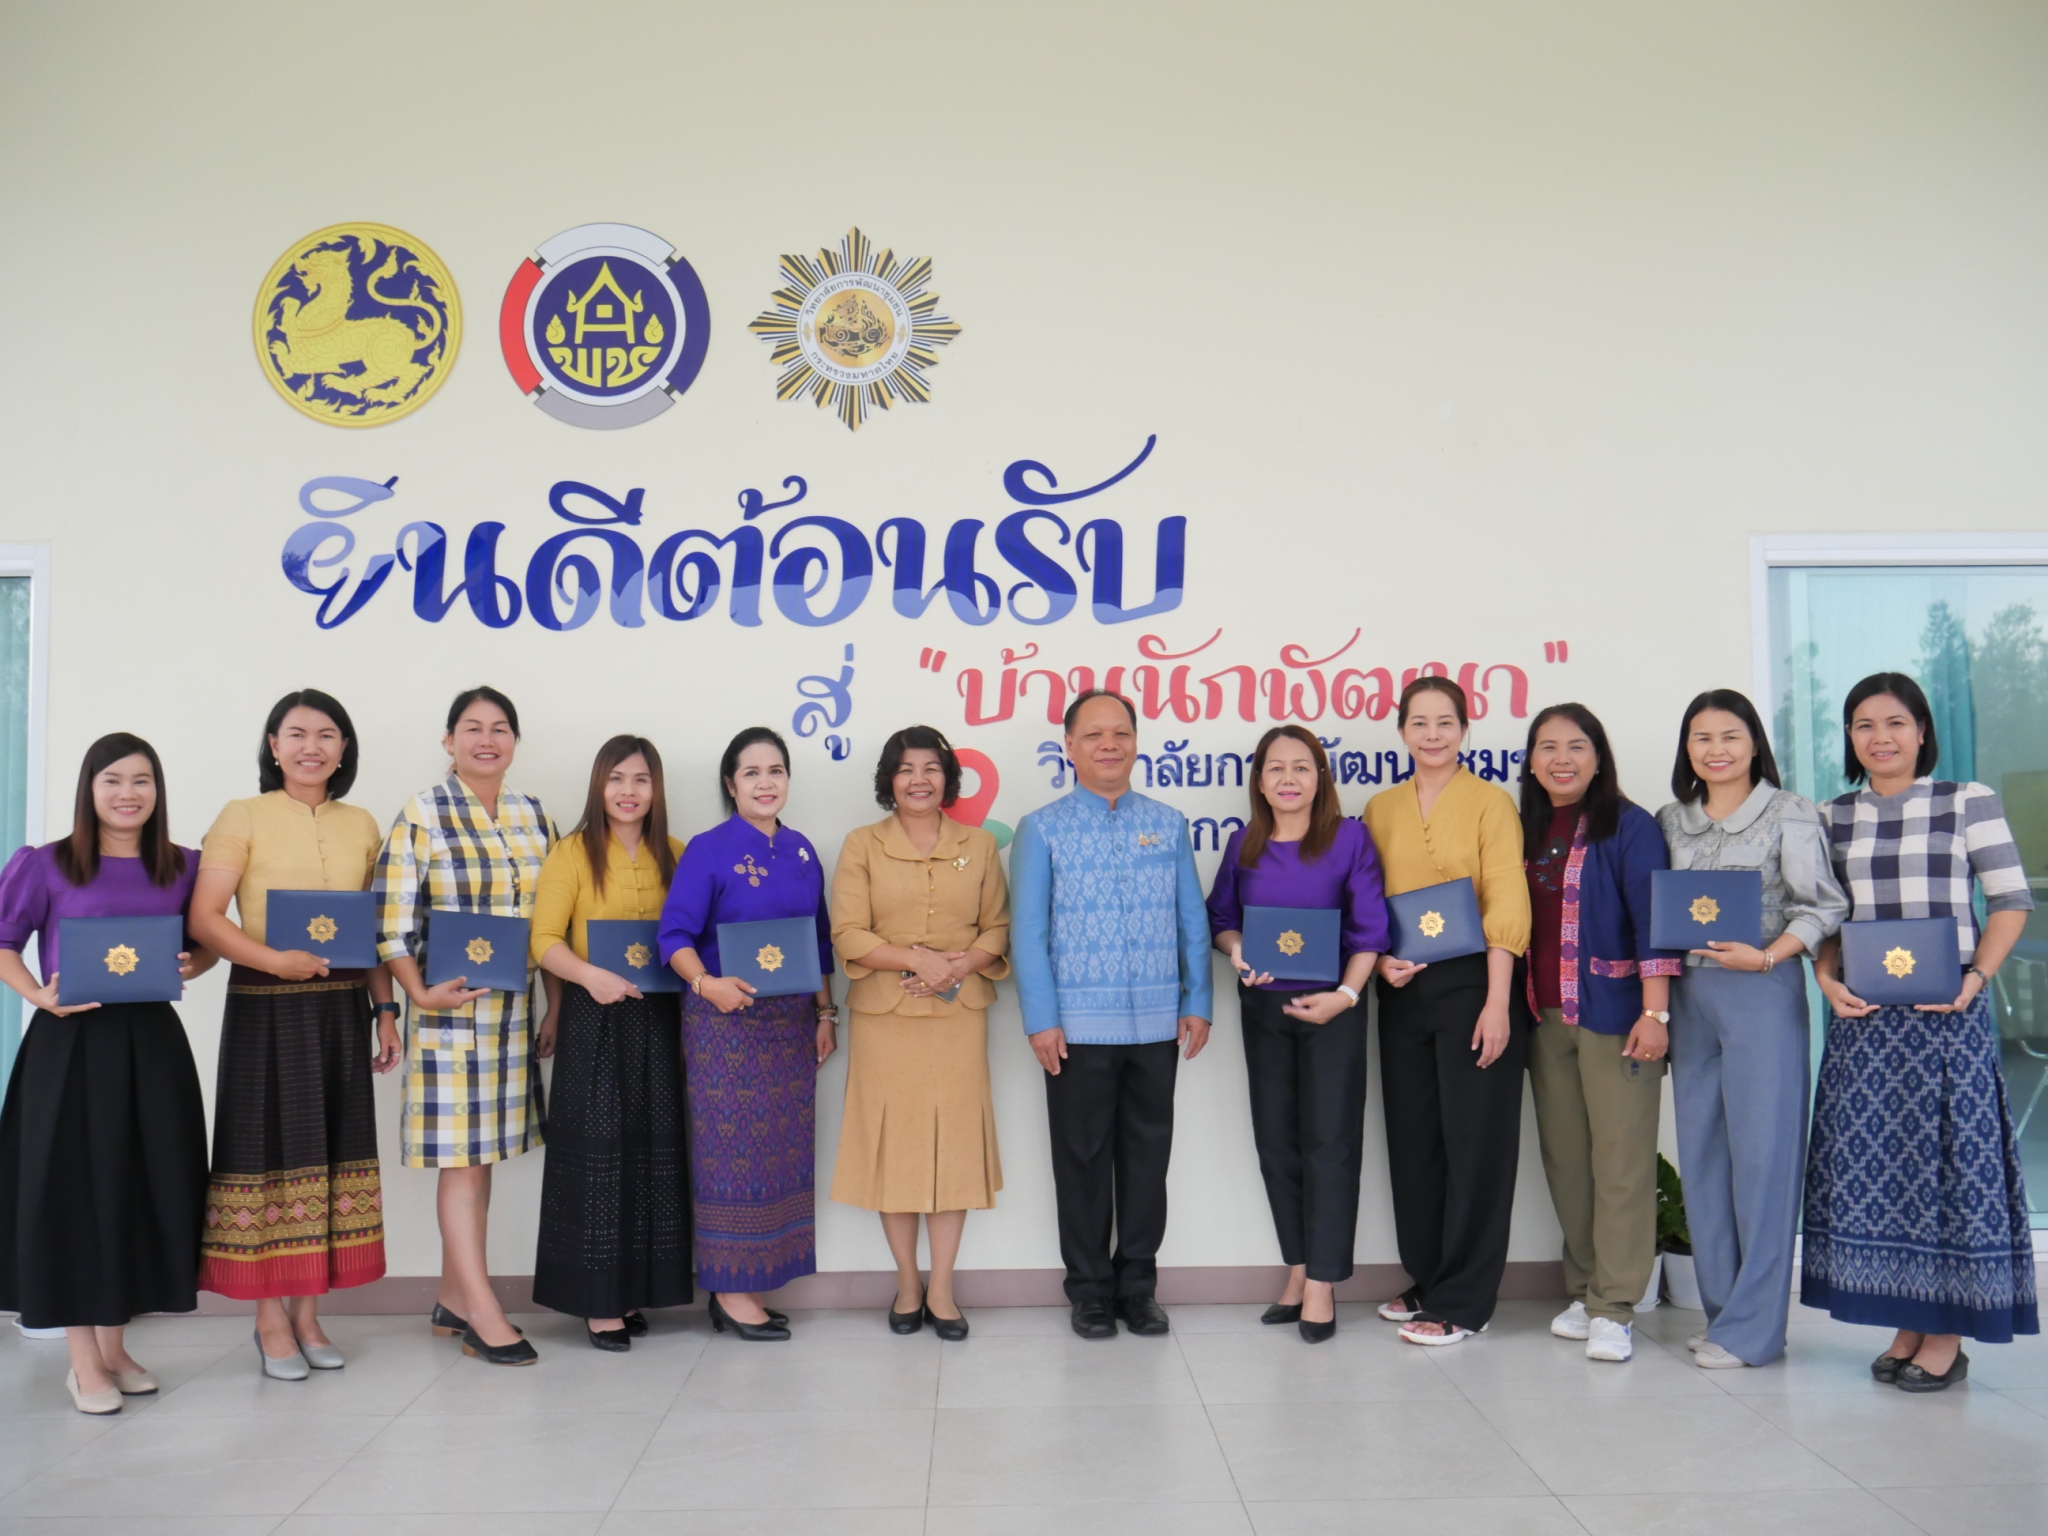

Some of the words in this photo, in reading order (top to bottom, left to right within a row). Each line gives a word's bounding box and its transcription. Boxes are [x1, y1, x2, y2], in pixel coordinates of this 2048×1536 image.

[811, 351, 899, 380] กระทรวงมหาดไทย
[281, 434, 1187, 631] ยินดีต้อนรับ
[792, 643, 854, 761] สู่
